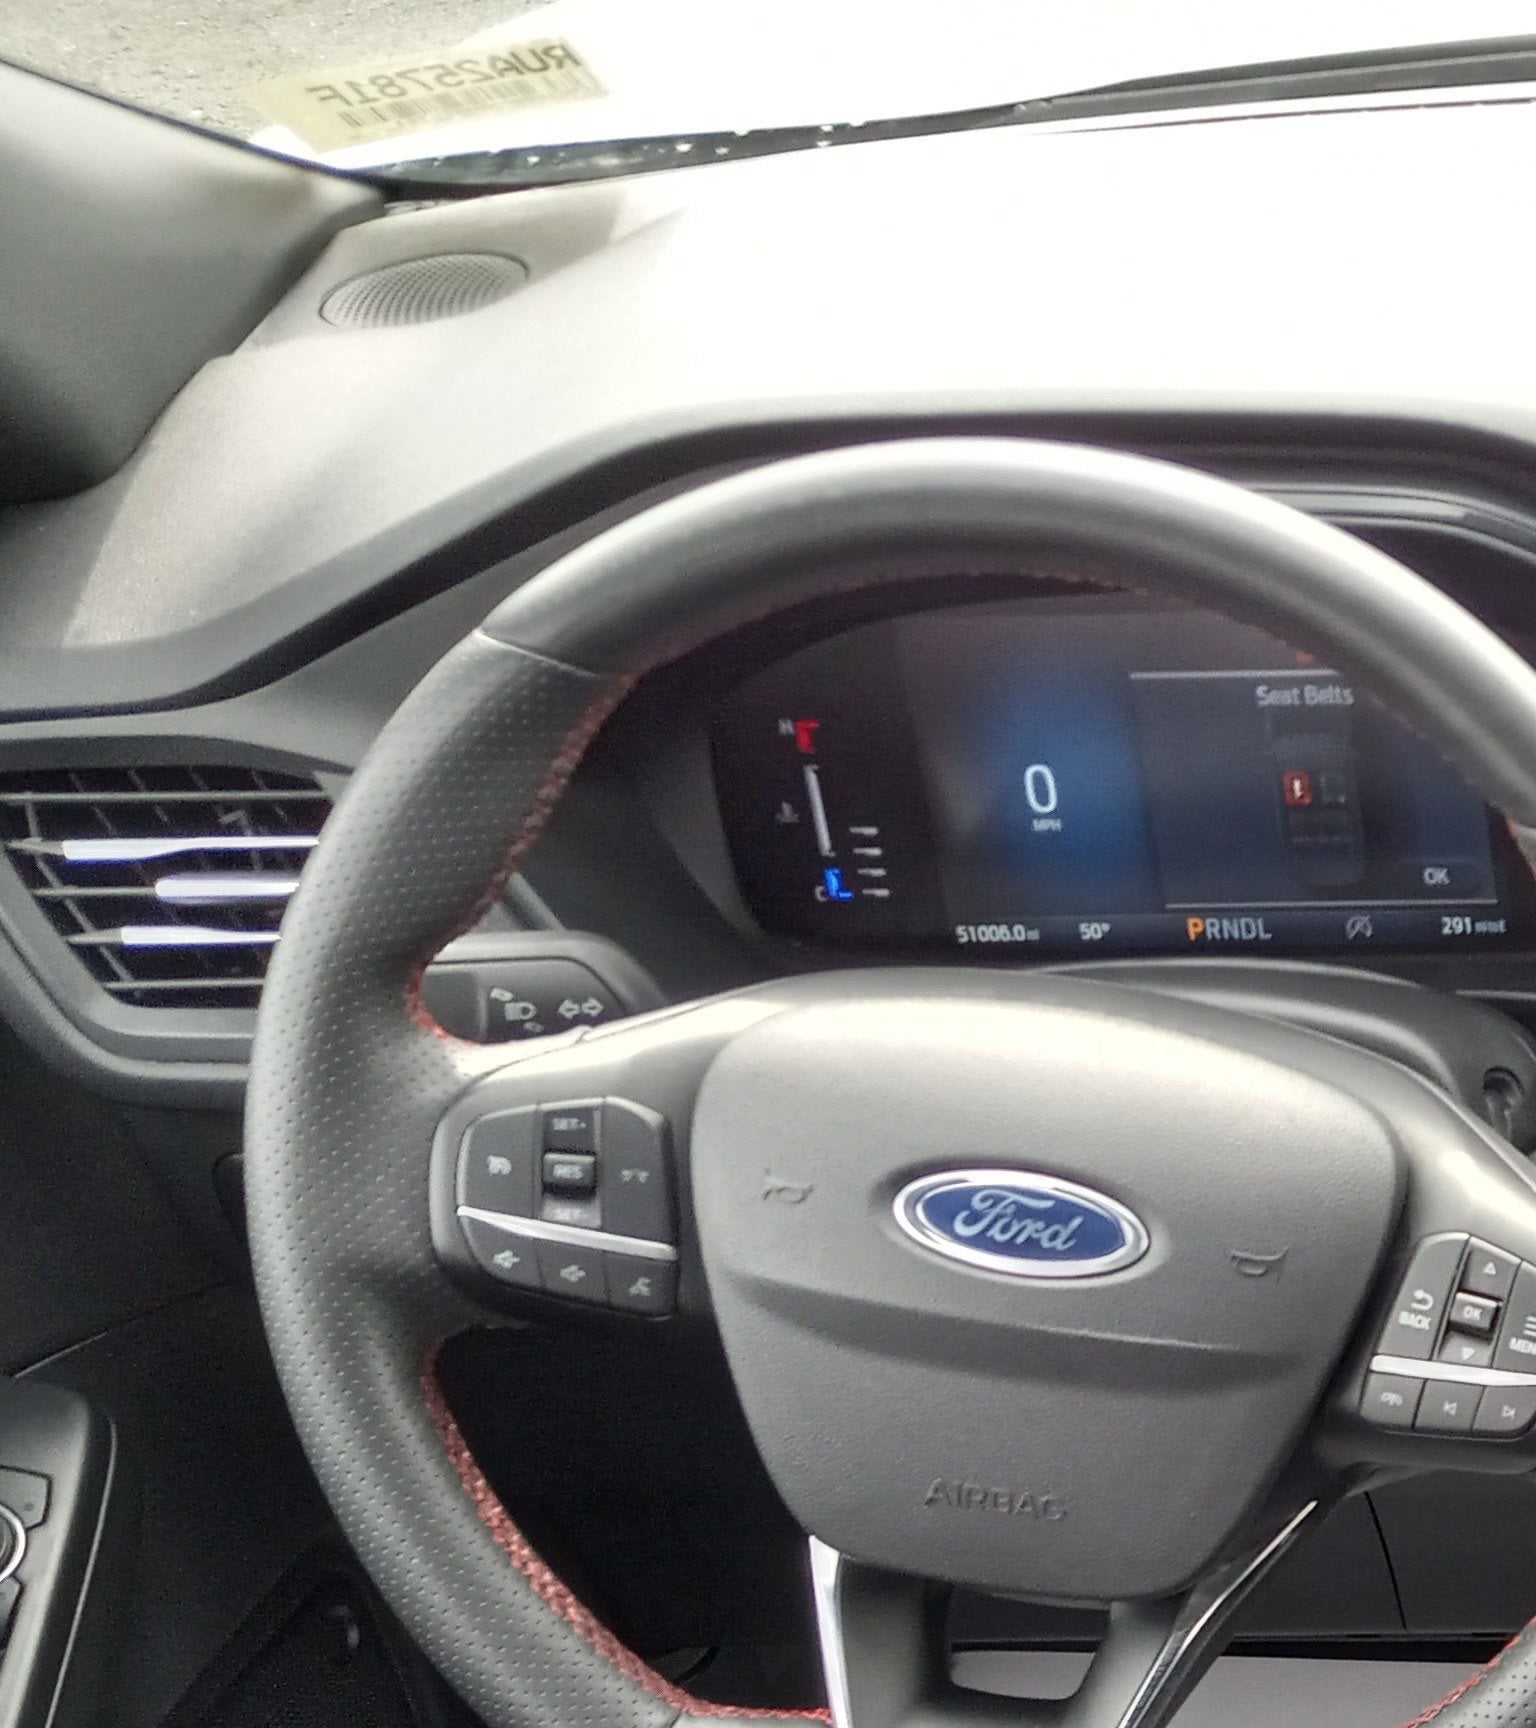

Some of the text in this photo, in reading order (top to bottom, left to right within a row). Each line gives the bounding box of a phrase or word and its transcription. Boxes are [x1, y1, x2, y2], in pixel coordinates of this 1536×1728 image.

[1255, 684, 1354, 707] Seat Belts
[1024, 764, 1058, 814] 0
[1423, 867, 1450, 886] OK
[1441, 916, 1472, 935] 291
[952, 1188, 1086, 1254] Ford
[1399, 1311, 1432, 1331] BACK
[1463, 1306, 1482, 1321] OK
[925, 1477, 1068, 1522] AIRBAG
